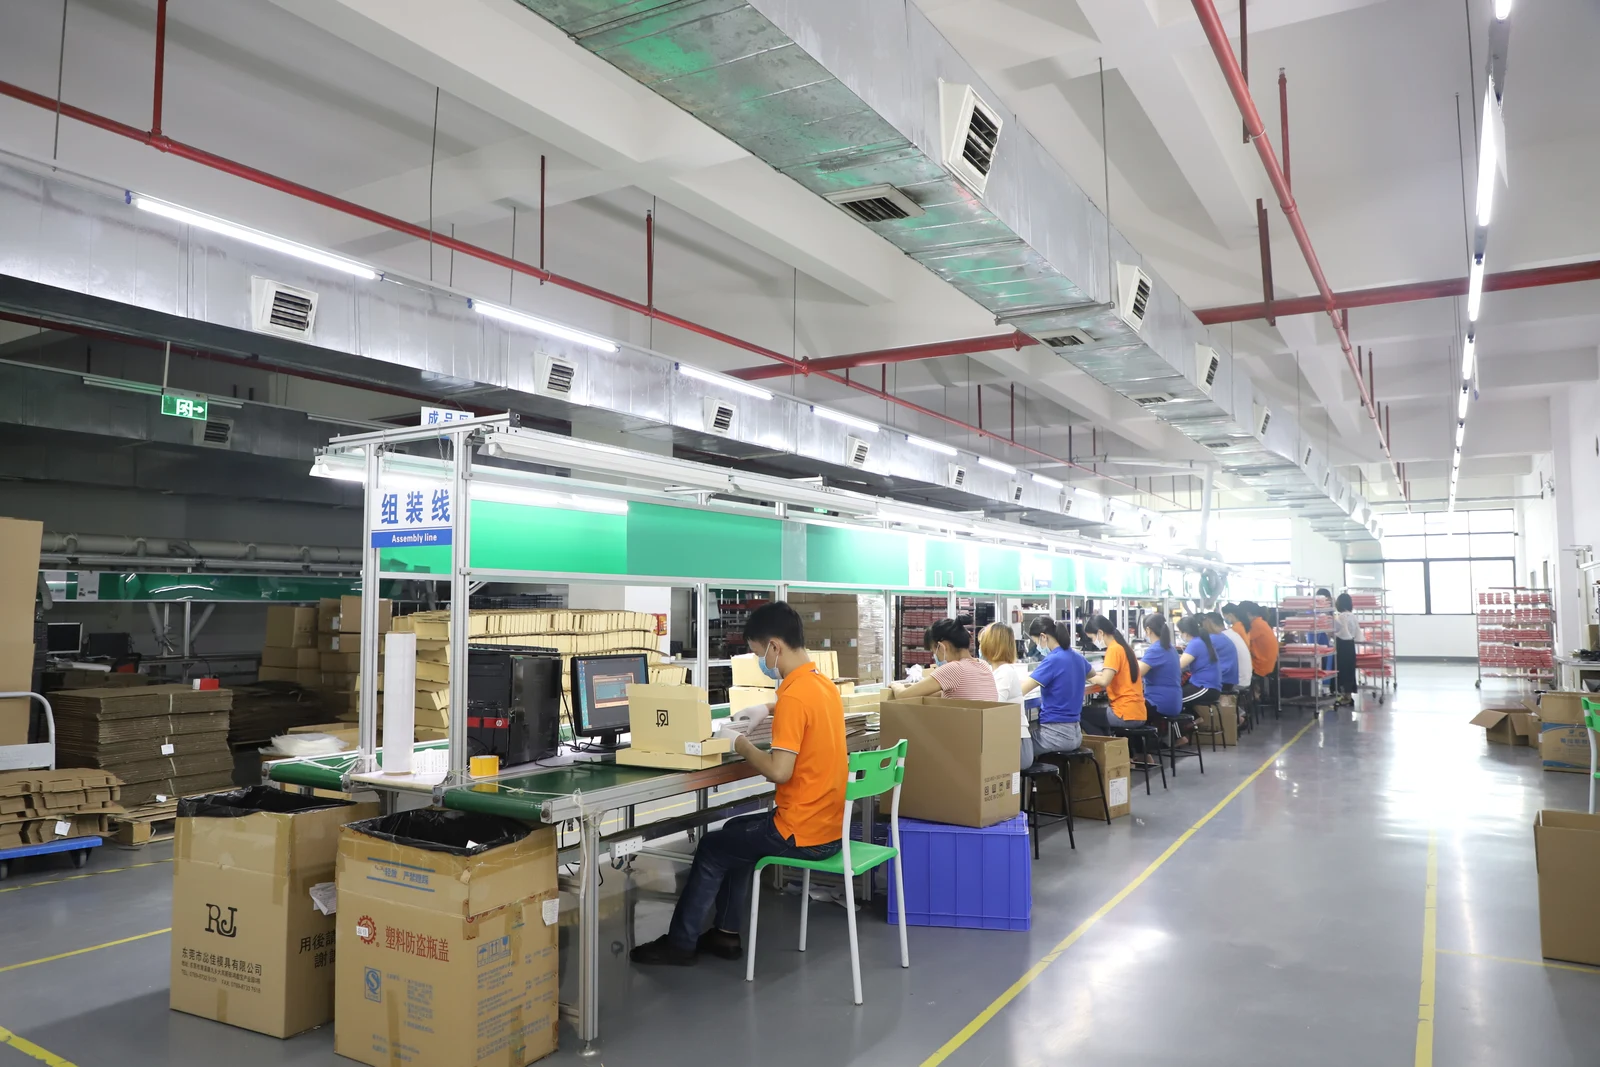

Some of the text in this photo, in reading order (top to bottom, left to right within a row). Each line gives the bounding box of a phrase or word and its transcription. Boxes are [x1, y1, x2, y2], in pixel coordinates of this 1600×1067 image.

[381, 489, 450, 524] 组装线
[391, 533, 437, 543] Assembly line
[204, 903, 238, 938] RJ
[385, 925, 450, 962] 塑料防盗瓶盖
